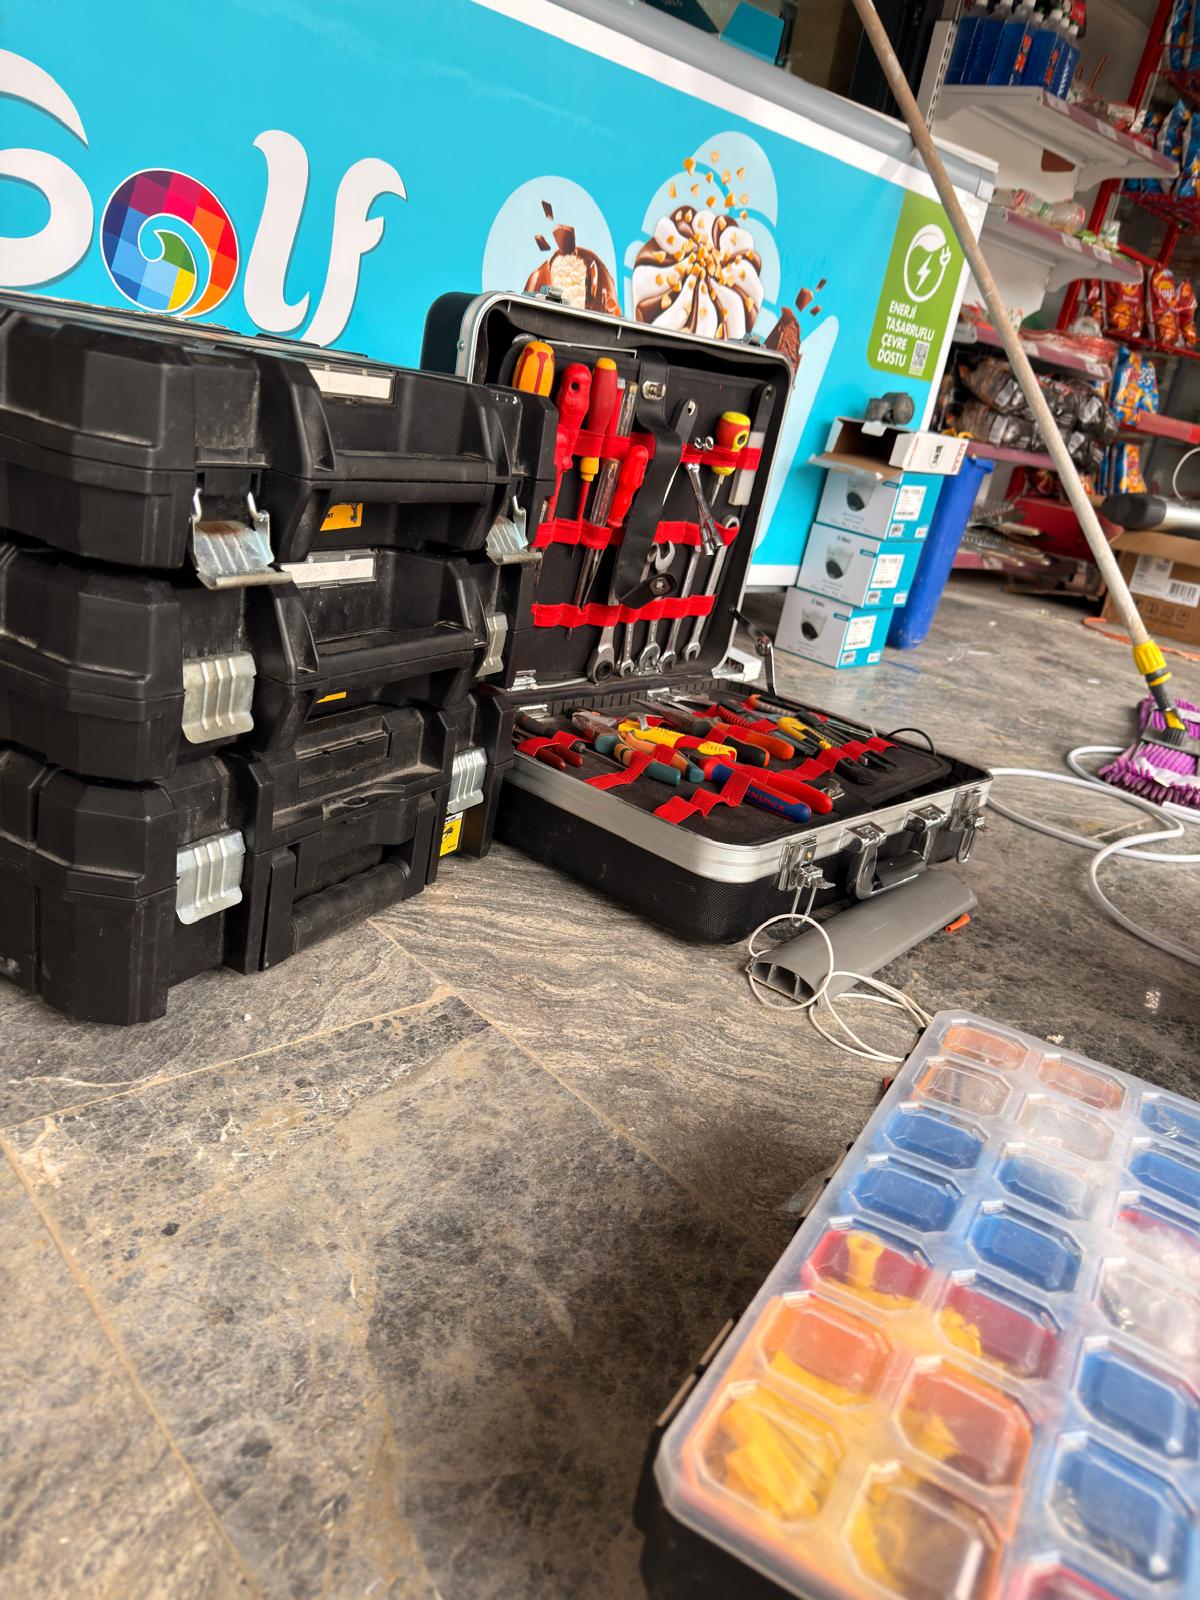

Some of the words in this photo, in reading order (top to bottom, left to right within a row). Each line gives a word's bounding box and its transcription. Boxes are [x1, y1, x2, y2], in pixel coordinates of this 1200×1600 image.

[889, 301, 917, 320] ENERJİ
[886, 316, 935, 341] TASARRUFLU
[881, 333, 908, 351] ÇEVRE
[877, 349, 907, 367] DOSTU
